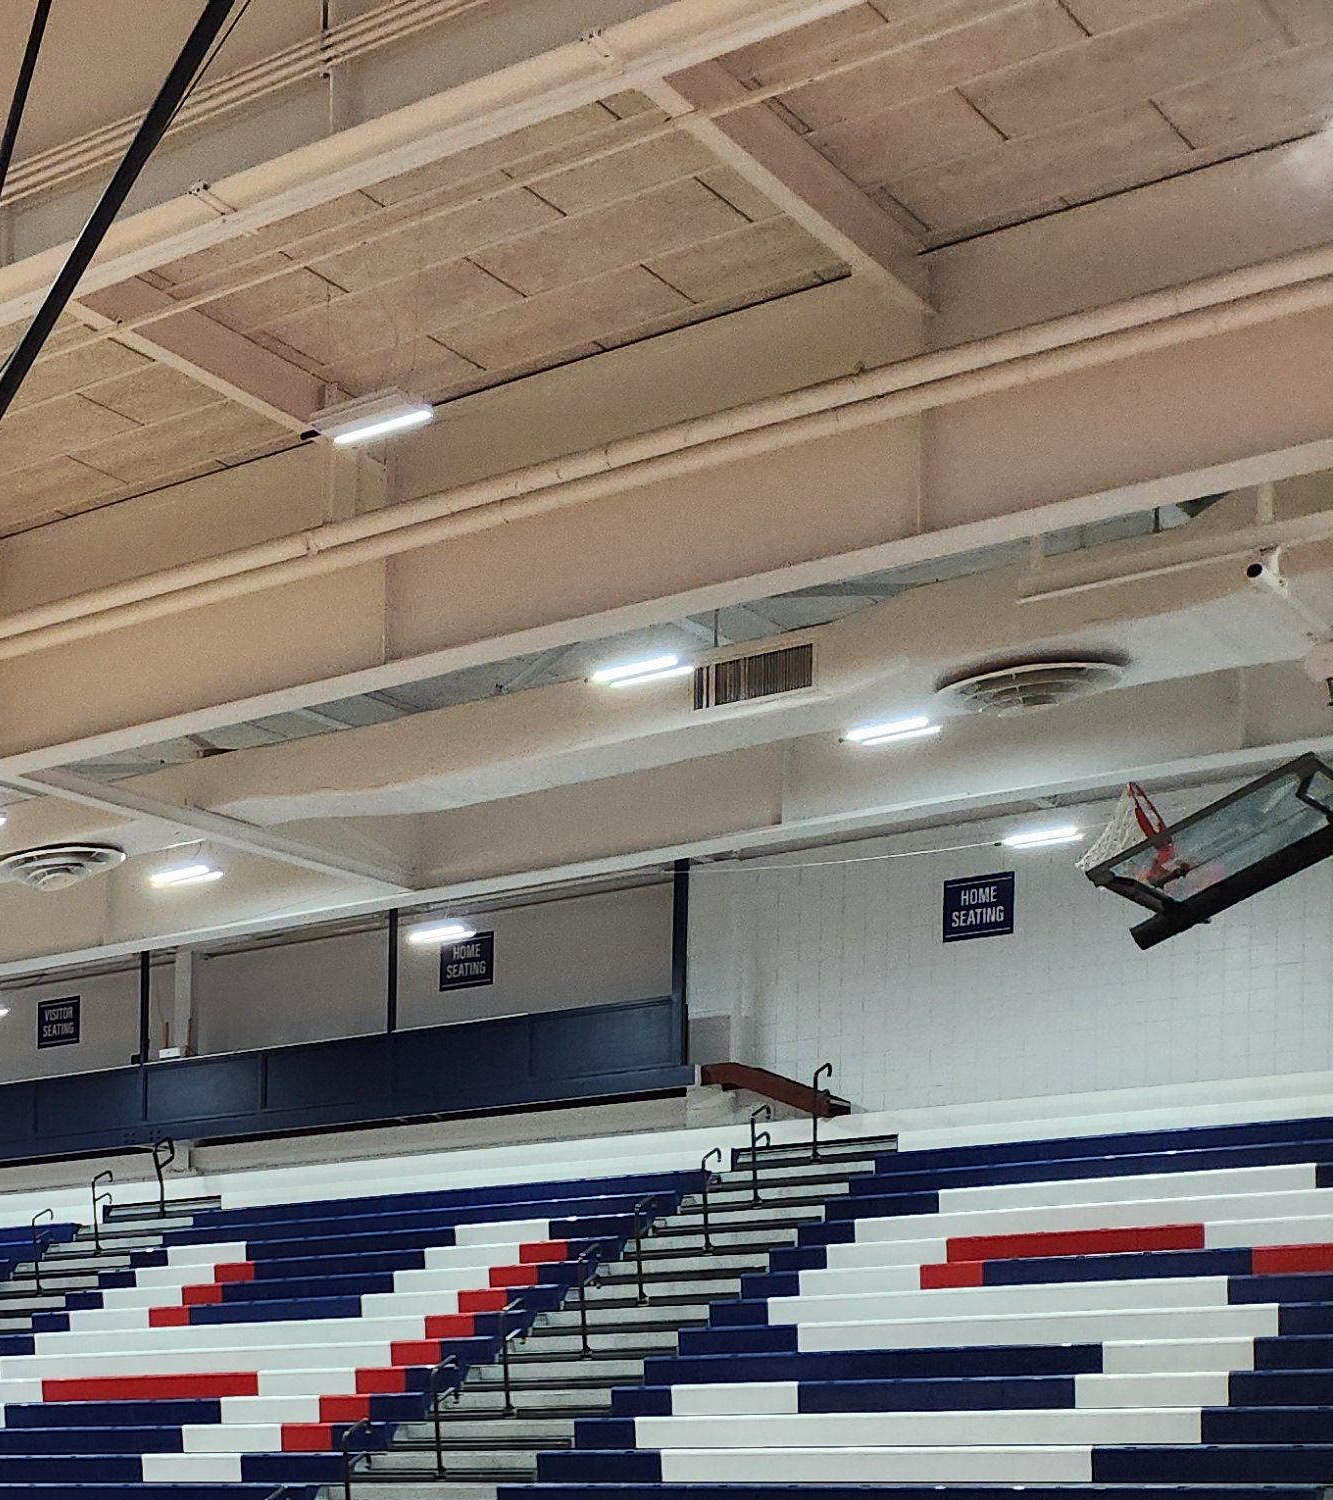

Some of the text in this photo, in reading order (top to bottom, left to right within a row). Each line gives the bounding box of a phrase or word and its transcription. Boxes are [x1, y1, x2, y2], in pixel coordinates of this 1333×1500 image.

[960, 886, 998, 906] HOME
[951, 906, 1005, 928] SEATING
[453, 943, 481, 960] HOME
[446, 961, 486, 979] SEATING
[44, 1006, 73, 1022] VISITOR
[43, 1022, 74, 1038] SEATING
